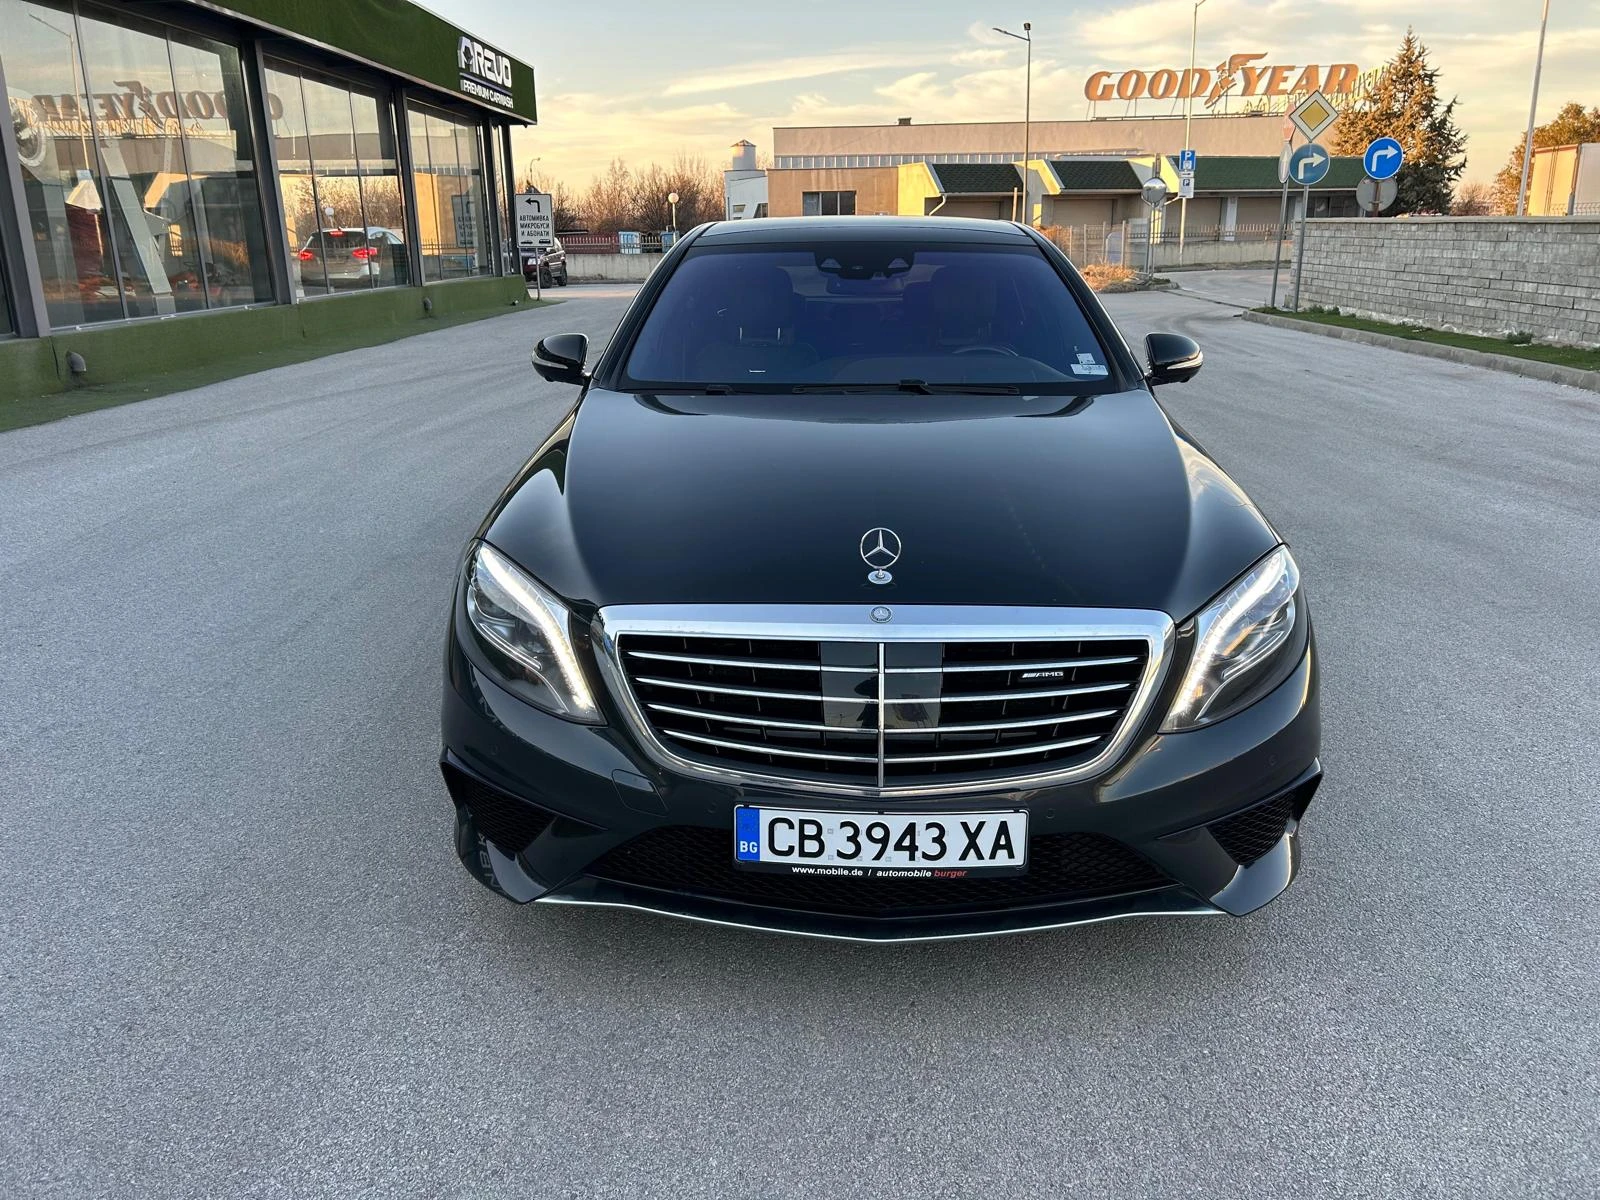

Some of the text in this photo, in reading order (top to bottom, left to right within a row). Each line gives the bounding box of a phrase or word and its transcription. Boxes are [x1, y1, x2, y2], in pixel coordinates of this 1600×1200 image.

[462, 80, 490, 100] PREMIUM
[1184, 151, 1192, 161] P
[768, 817, 1016, 862] CB 3943 XA
[739, 841, 758, 854] BG
[791, 866, 864, 877] www.mobile.de
[876, 869, 932, 878] automobile
[934, 869, 968, 879] burger
